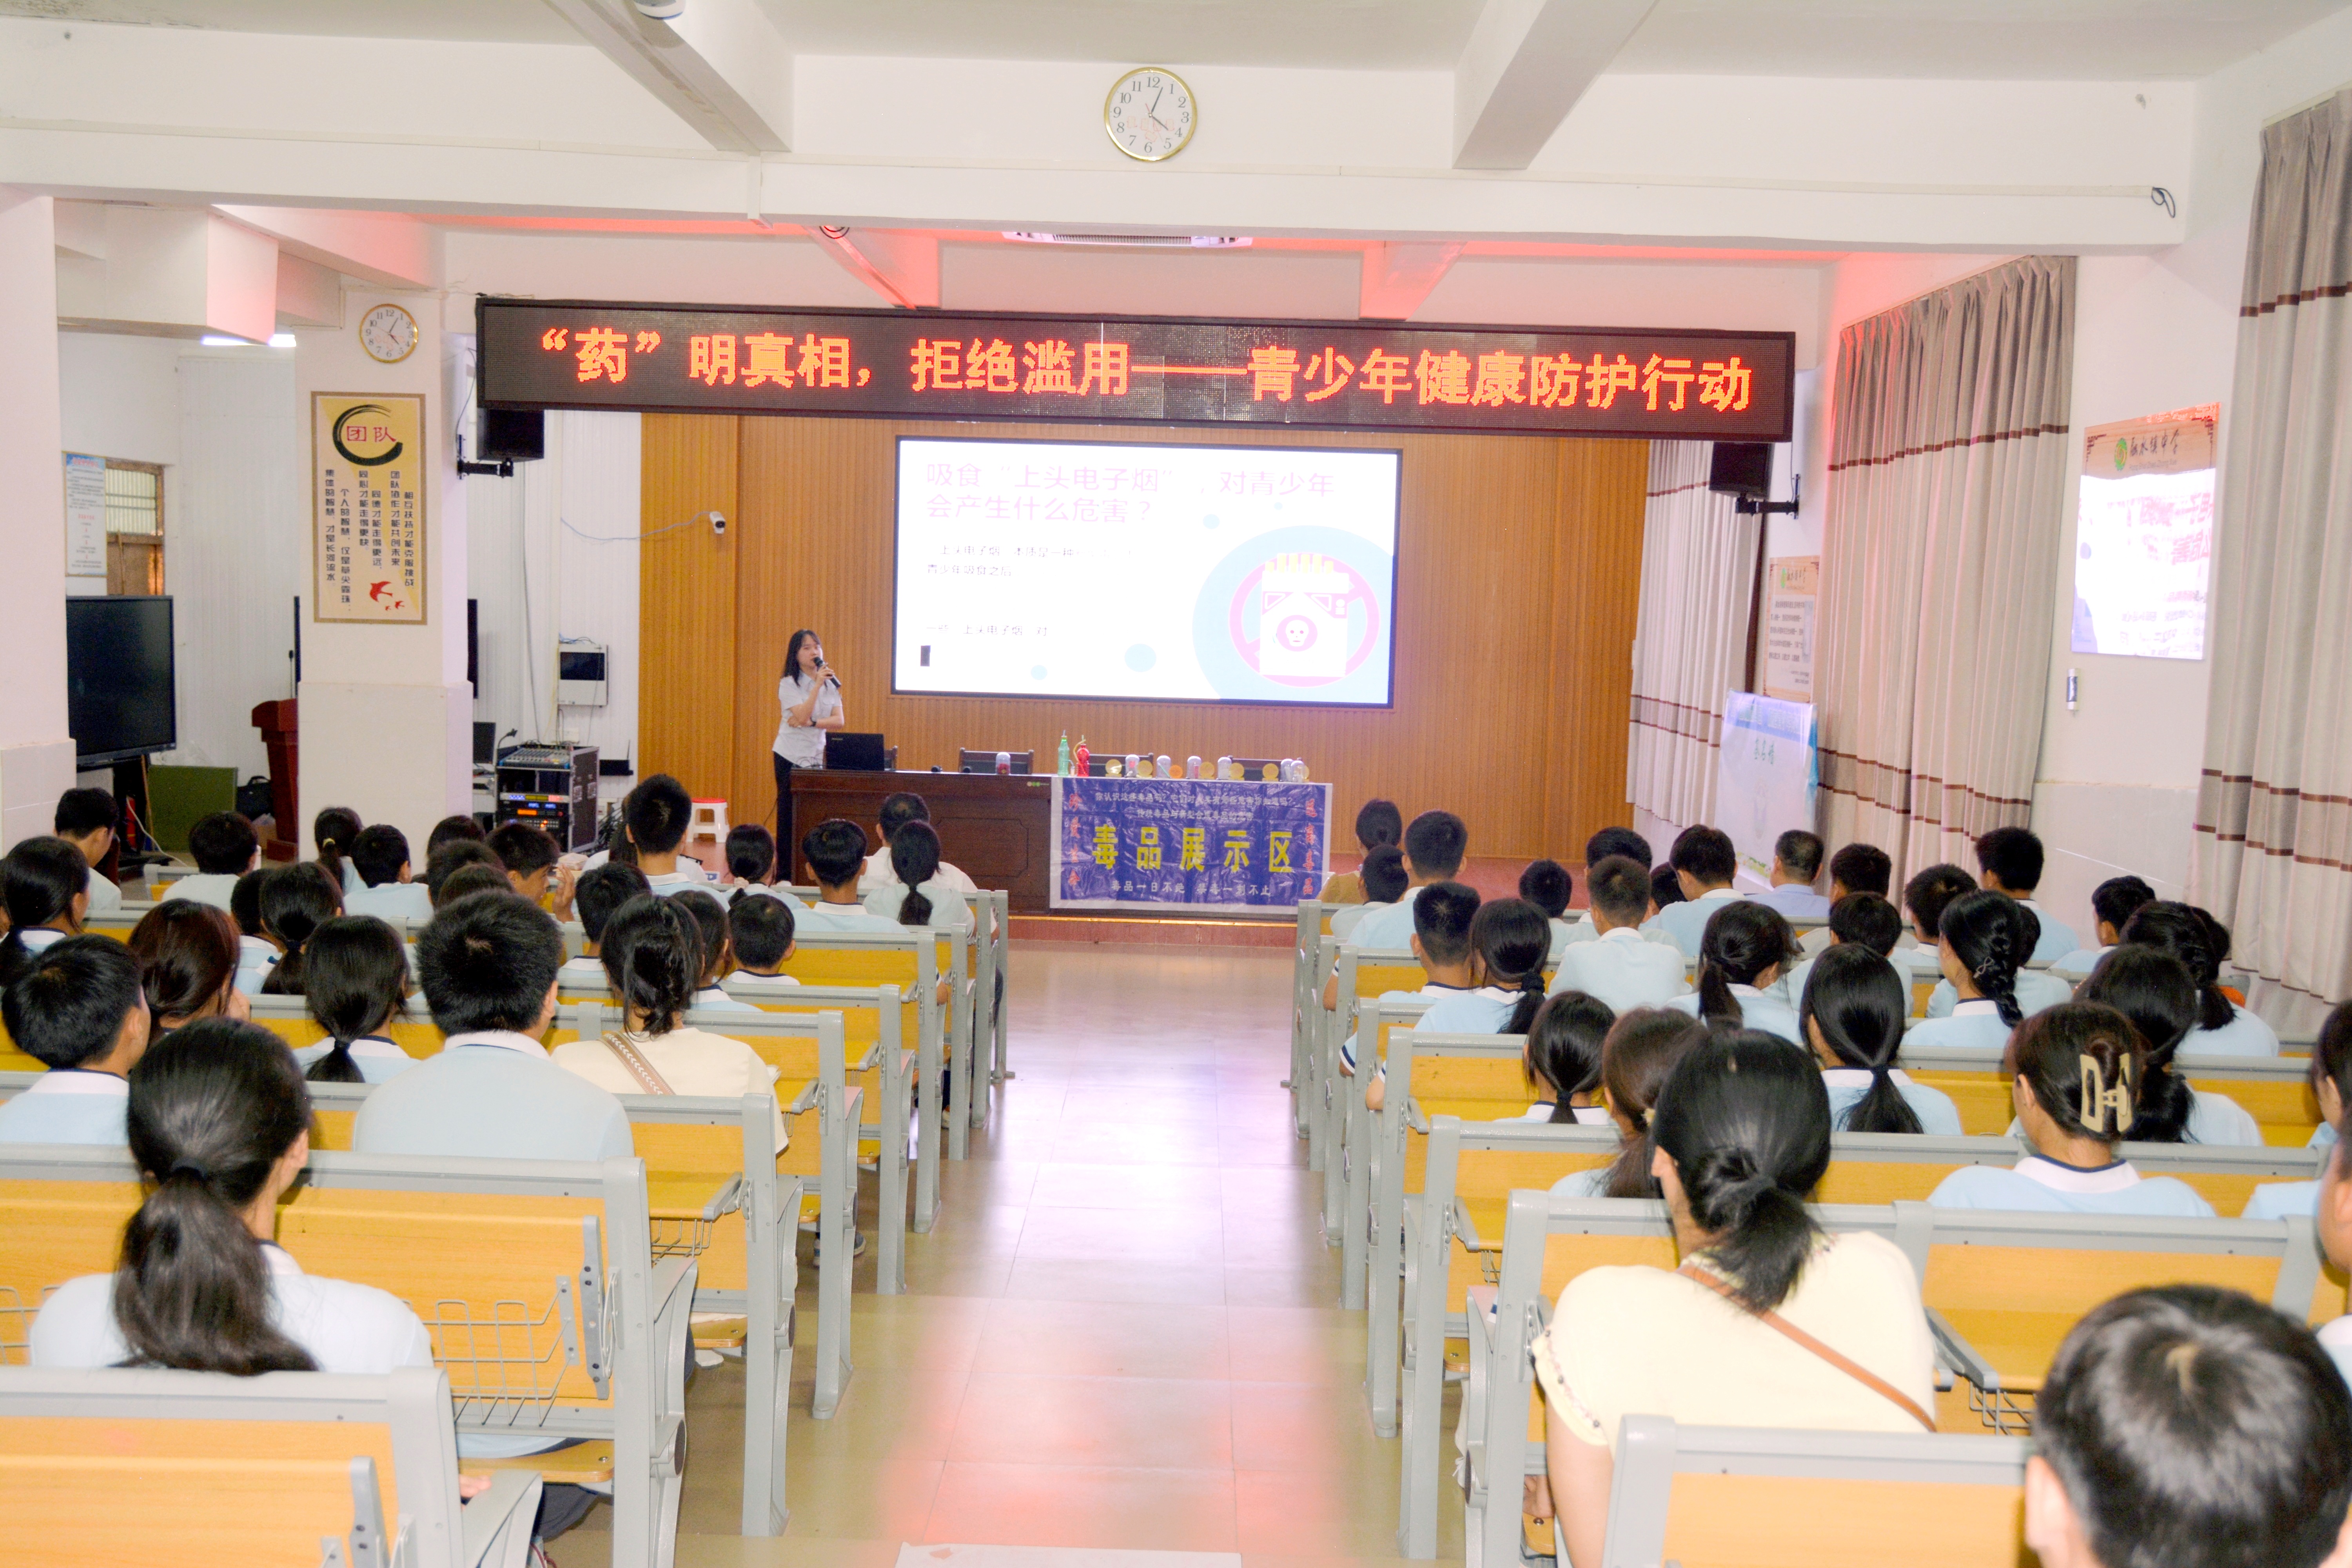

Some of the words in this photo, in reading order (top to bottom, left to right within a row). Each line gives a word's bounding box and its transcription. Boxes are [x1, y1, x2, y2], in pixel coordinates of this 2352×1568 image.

[1132, 81, 1141, 92] 11
[1147, 77, 1160, 88] 12
[1169, 83, 1174, 94] 1
[1120, 93, 1131, 103] 10
[1178, 97, 1186, 108] 2
[1113, 107, 1121, 118] 9
[1181, 112, 1189, 123] 3
[1117, 122, 1124, 133] 8
[1175, 127, 1182, 137] 4
[1129, 135, 1136, 146] 7
[1164, 138, 1171, 149] 5
[1144, 142, 1152, 153] 6
[347, 426, 396, 443] 团队
[926, 494, 1151, 524] 会产生什么危害？
[390, 471, 400, 566] 团队协作才能共创未来
[927, 564, 1011, 576] 青少年吸食之后
[1092, 824, 1292, 873] 毒品展示区
[1111, 882, 1185, 894] 毒品一日不绝
